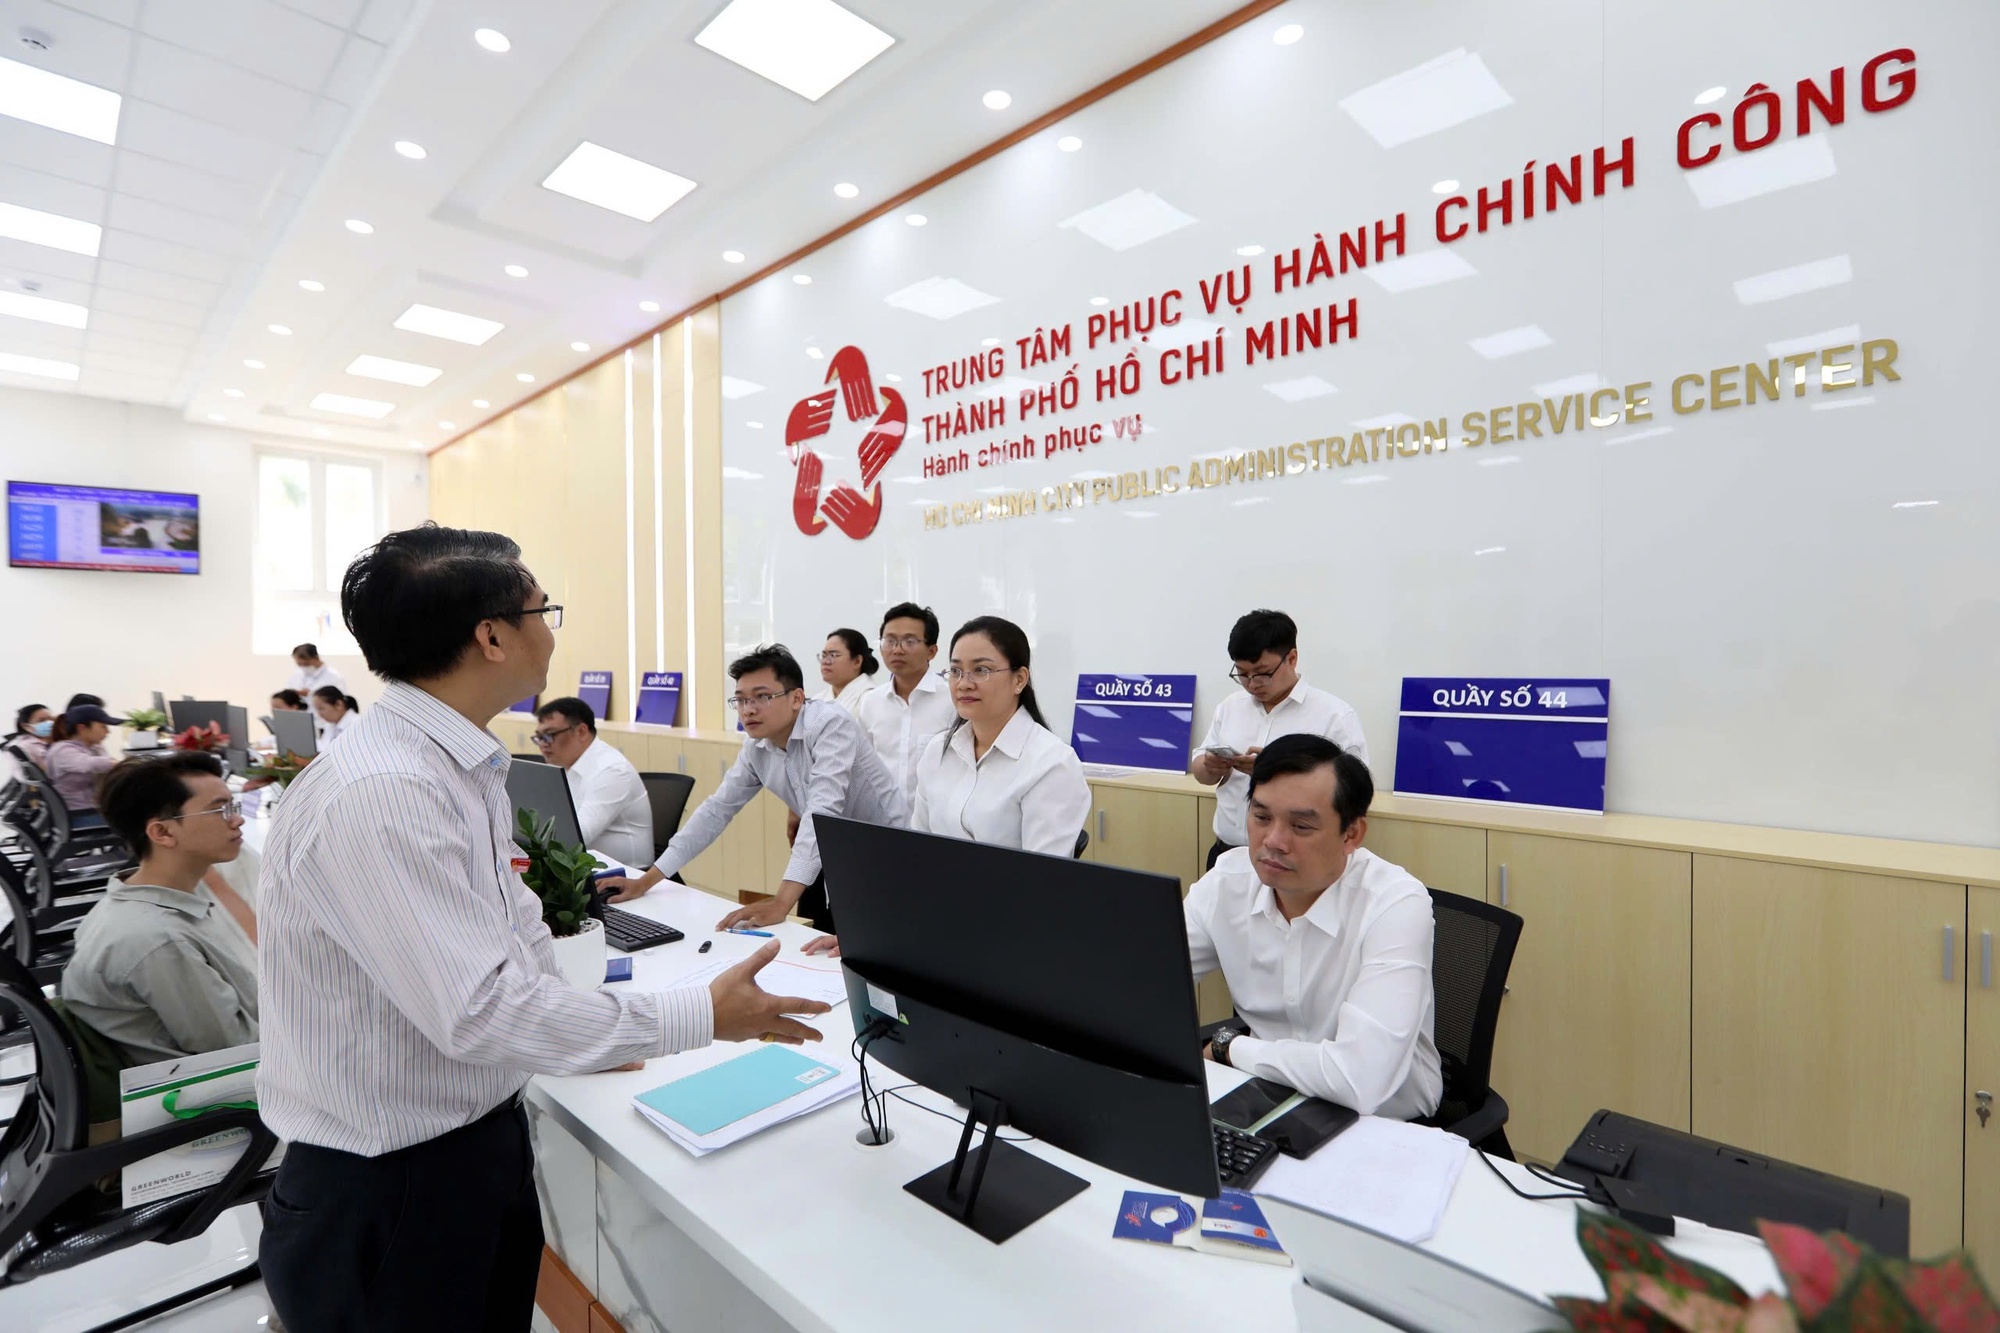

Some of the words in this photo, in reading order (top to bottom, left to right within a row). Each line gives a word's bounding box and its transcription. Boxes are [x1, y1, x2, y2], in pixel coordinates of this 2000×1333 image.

[922, 347, 1004, 398] TRUNG
[1016, 323, 1072, 371] TÂM
[1088, 289, 1184, 350] PHỤC
[1199, 264, 1251, 315] VỤ
[1274, 212, 1406, 293] HÀNH
[1435, 136, 1635, 244] CHÍNH
[1676, 47, 1917, 170] CÔNG
[922, 396, 1005, 444] THÀNH
[1019, 363, 1080, 421] PHỐ
[1096, 346, 1141, 402] HỒ
[1159, 326, 1225, 386] CHÍ
[1246, 297, 1360, 365] MINH
[923, 503, 948, 530] HO
[952, 500, 982, 527] CHI
[987, 490, 1036, 520] MINH
[1041, 480, 1088, 512] CITY
[1092, 465, 1180, 504] PUBLIC
[1187, 417, 1449, 491] ADMINISTRATION
[1461, 381, 1654, 447] SERVICE
[1671, 338, 1902, 415] CENTER
[923, 449, 970, 478] Hành
[977, 434, 1036, 468] chính
[1044, 423, 1103, 459] phục
[1112, 414, 1143, 441] vụ
[1095, 678, 1131, 697] QUẦY
[1133, 679, 1153, 696] SỐ
[1155, 684, 1172, 697] 43
[1432, 683, 1494, 707] QUẦY
[1500, 684, 1531, 707] SỐ
[1538, 691, 1568, 708] 44
[131, 1169, 192, 1192] GREENWORLD
